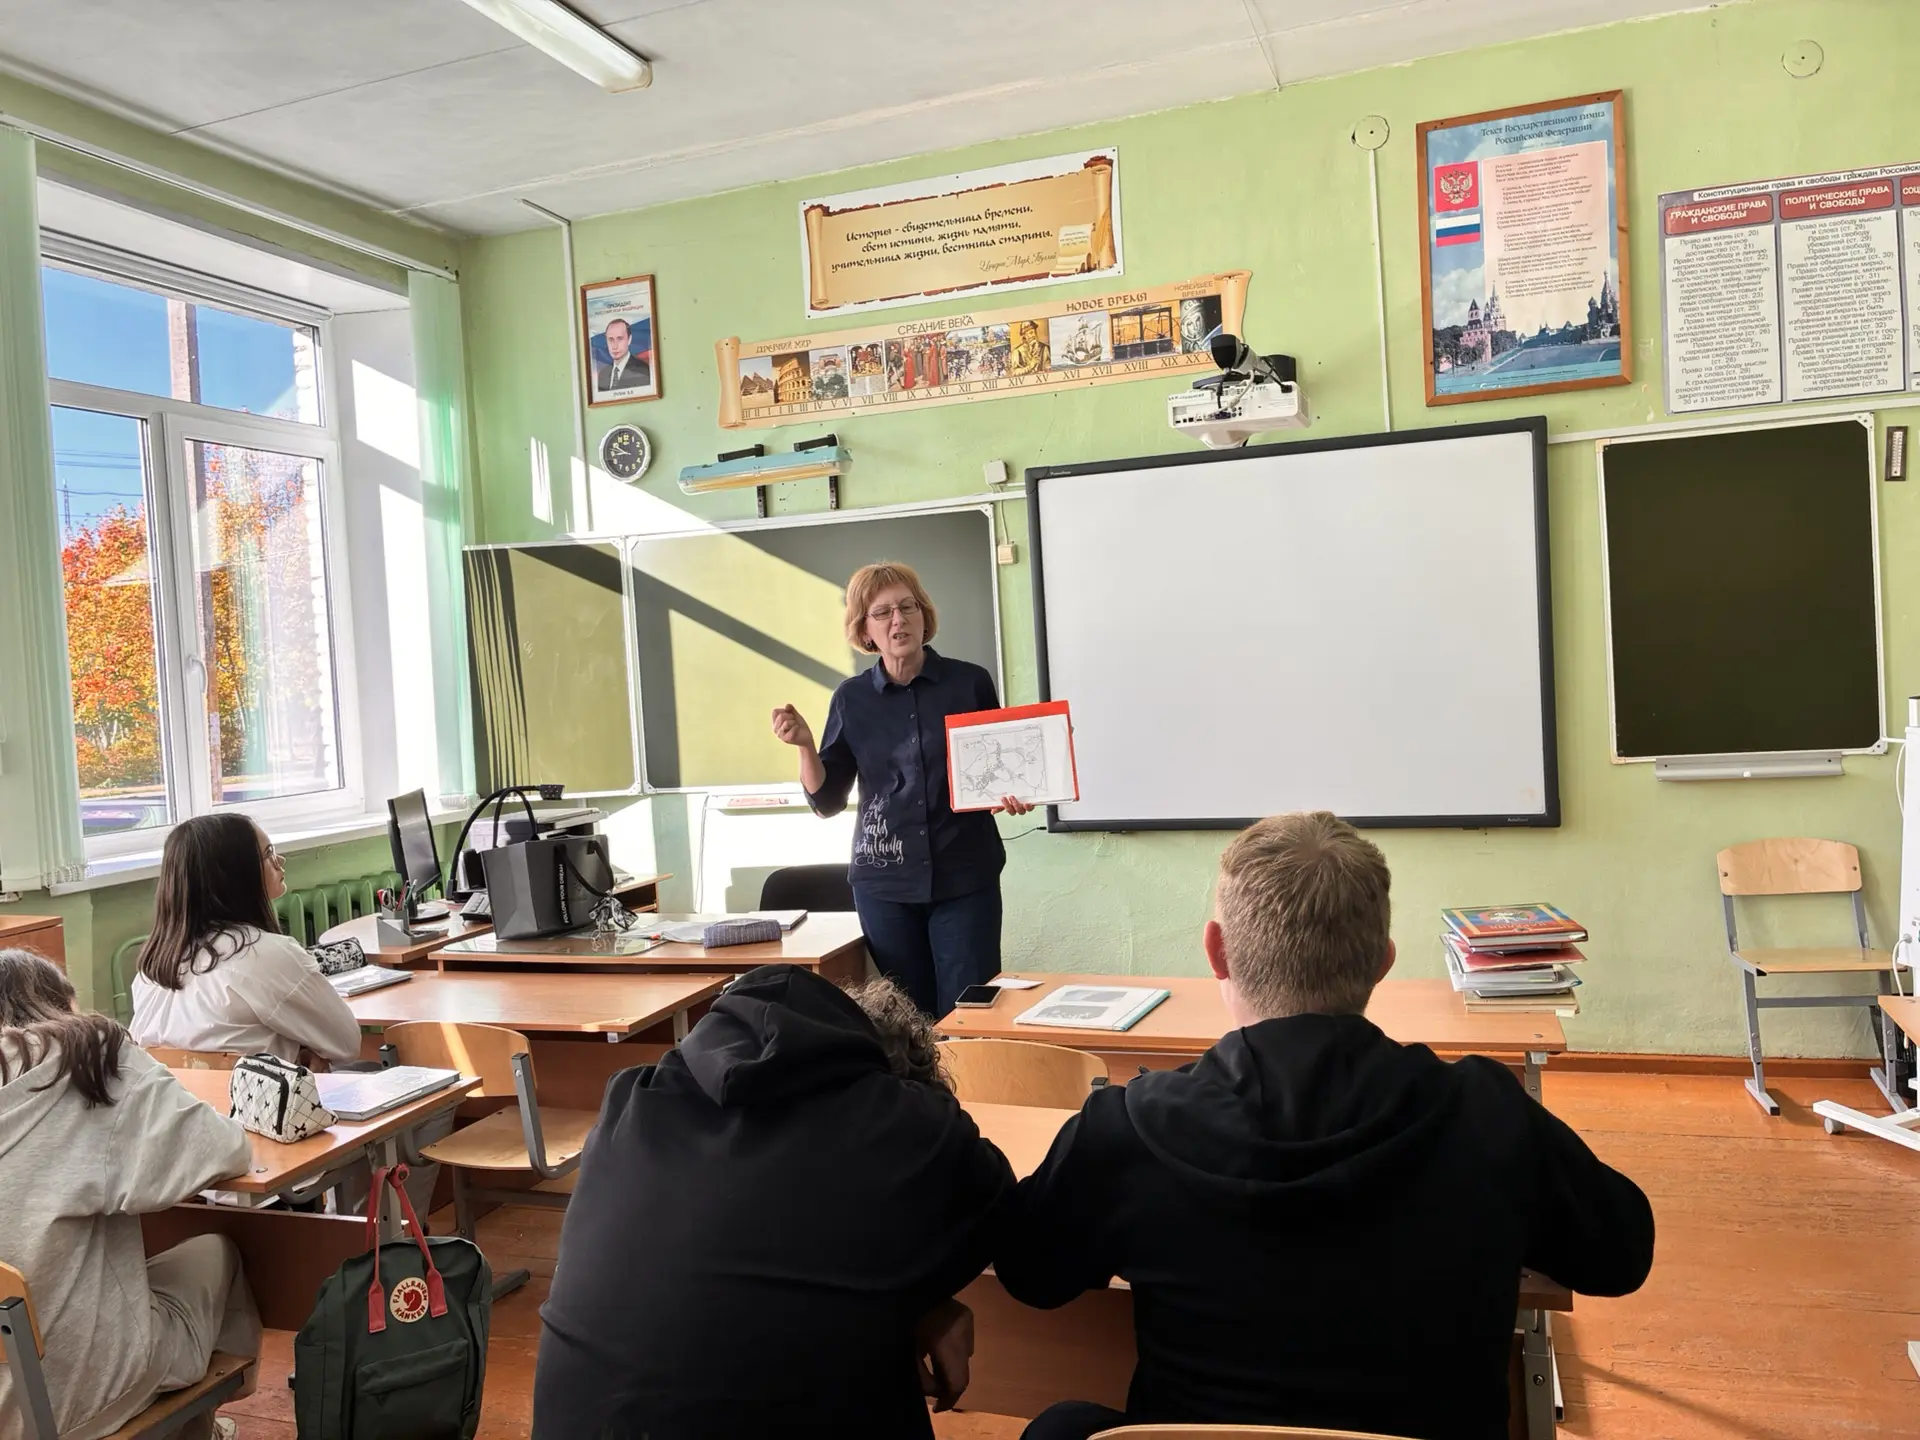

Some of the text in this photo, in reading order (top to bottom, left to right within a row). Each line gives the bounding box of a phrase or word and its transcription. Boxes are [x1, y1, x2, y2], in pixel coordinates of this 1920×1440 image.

[1481, 125, 1502, 136] Текст
[1698, 183, 1768, 199] Конституционные
[1771, 181, 1795, 189] права
[1806, 174, 1840, 185] свободы
[1843, 169, 1877, 180] граждан
[1785, 185, 1889, 206] ПОЛИТИЧЕСКИЕ ПРАВА
[1809, 196, 1865, 210] И СВОБОДЫ
[1670, 199, 1766, 219] ГРАЖДАНСКИЕ ПРАВА
[1701, 209, 1746, 223] СВОБОДЫ
[846, 226, 892, 243] История
[901, 211, 982, 235] свидетельница
[1795, 222, 1816, 231] Право
[1818, 220, 1826, 228] на
[1828, 216, 1856, 227] свободу
[861, 239, 887, 252] свет
[937, 228, 970, 243] жизнь
[1679, 237, 1700, 246] Право
[1702, 235, 1710, 243] на
[1748, 228, 1758, 237] 20)
[831, 253, 901, 272] учительница
[941, 236, 995, 254] вестница
[1673, 256, 1694, 265] Право
[1706, 251, 1732, 261] свободу
[1786, 261, 1807, 270] Право
[1882, 250, 1893, 258] 30)
[1795, 266, 1817, 275] Право
[1066, 292, 1148, 313] НОВОЕ ВРЕМЯ
[898, 314, 975, 336] СРЕДНИЕ ВЕКА
[1678, 354, 1699, 363] Право
[1711, 349, 1738, 359] свободу
[1797, 360, 1819, 368] Право
[861, 395, 874, 405] VII
[882, 392, 898, 403] VIII
[906, 390, 916, 400] IX
[925, 388, 932, 397] X
[939, 386, 949, 396] XI
[958, 383, 971, 393] XII
[982, 380, 998, 391] XIII
[1008, 376, 1025, 388] XIV
[1035, 373, 1049, 384] XV
[1062, 369, 1081, 381] XVI
[1091, 365, 1113, 377] XVII
[1124, 360, 1149, 374] XVIII
[1160, 356, 1179, 369] XIX
[1185, 353, 1201, 365] XX
[1710, 391, 1753, 403] Конституции
[560, 900, 570, 924] FOLLOW
